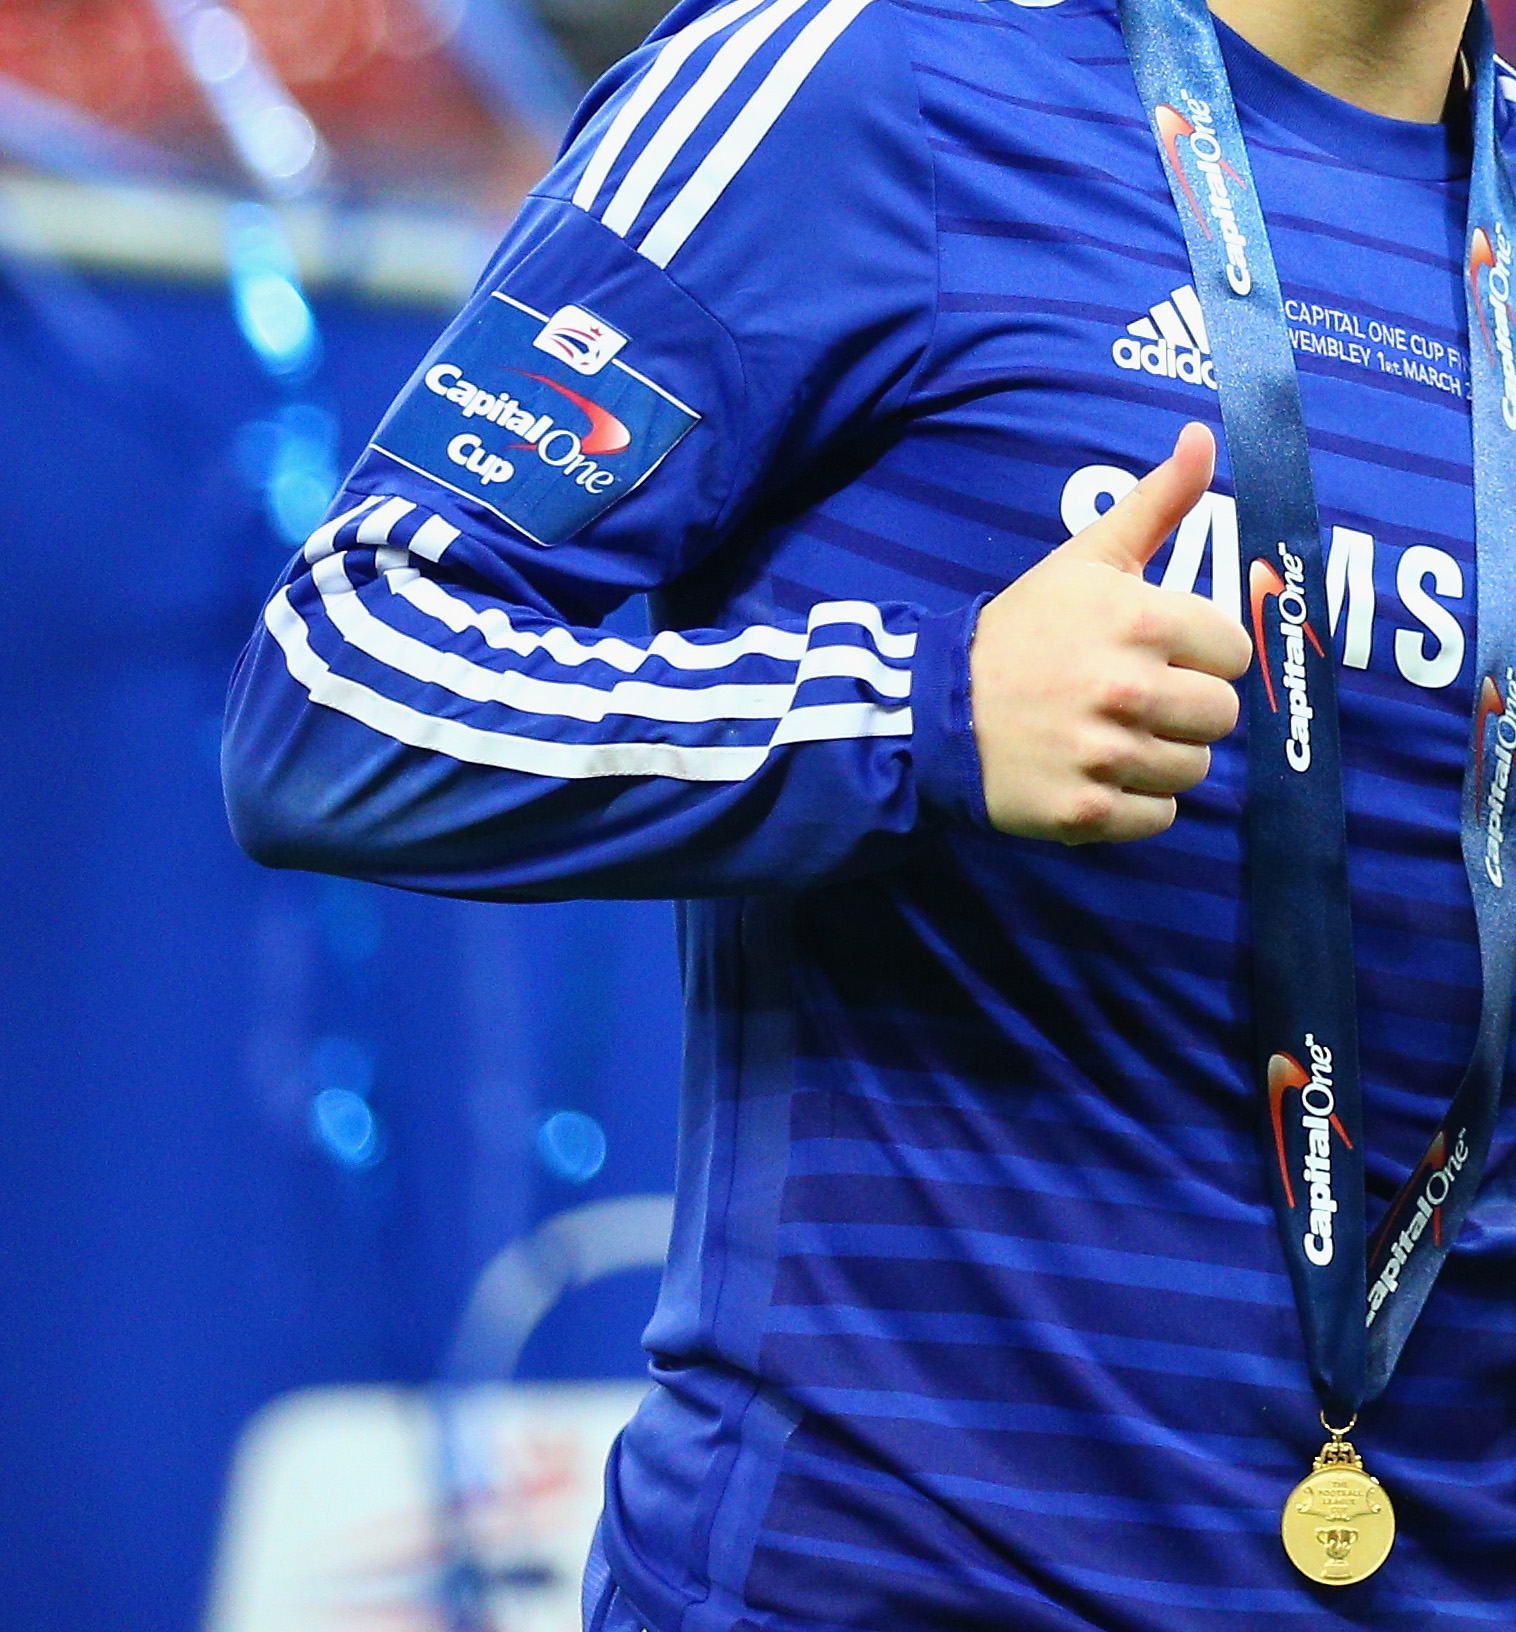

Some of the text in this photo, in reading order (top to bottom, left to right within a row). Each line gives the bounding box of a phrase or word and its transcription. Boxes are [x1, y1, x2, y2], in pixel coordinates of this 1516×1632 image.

[1284, 299, 1366, 340] CAPITAL
[1368, 320, 1408, 351] ONE
[1410, 334, 1444, 362] CUP
[1402, 357, 1462, 398] MARCH
[446, 432, 515, 486] Cup
